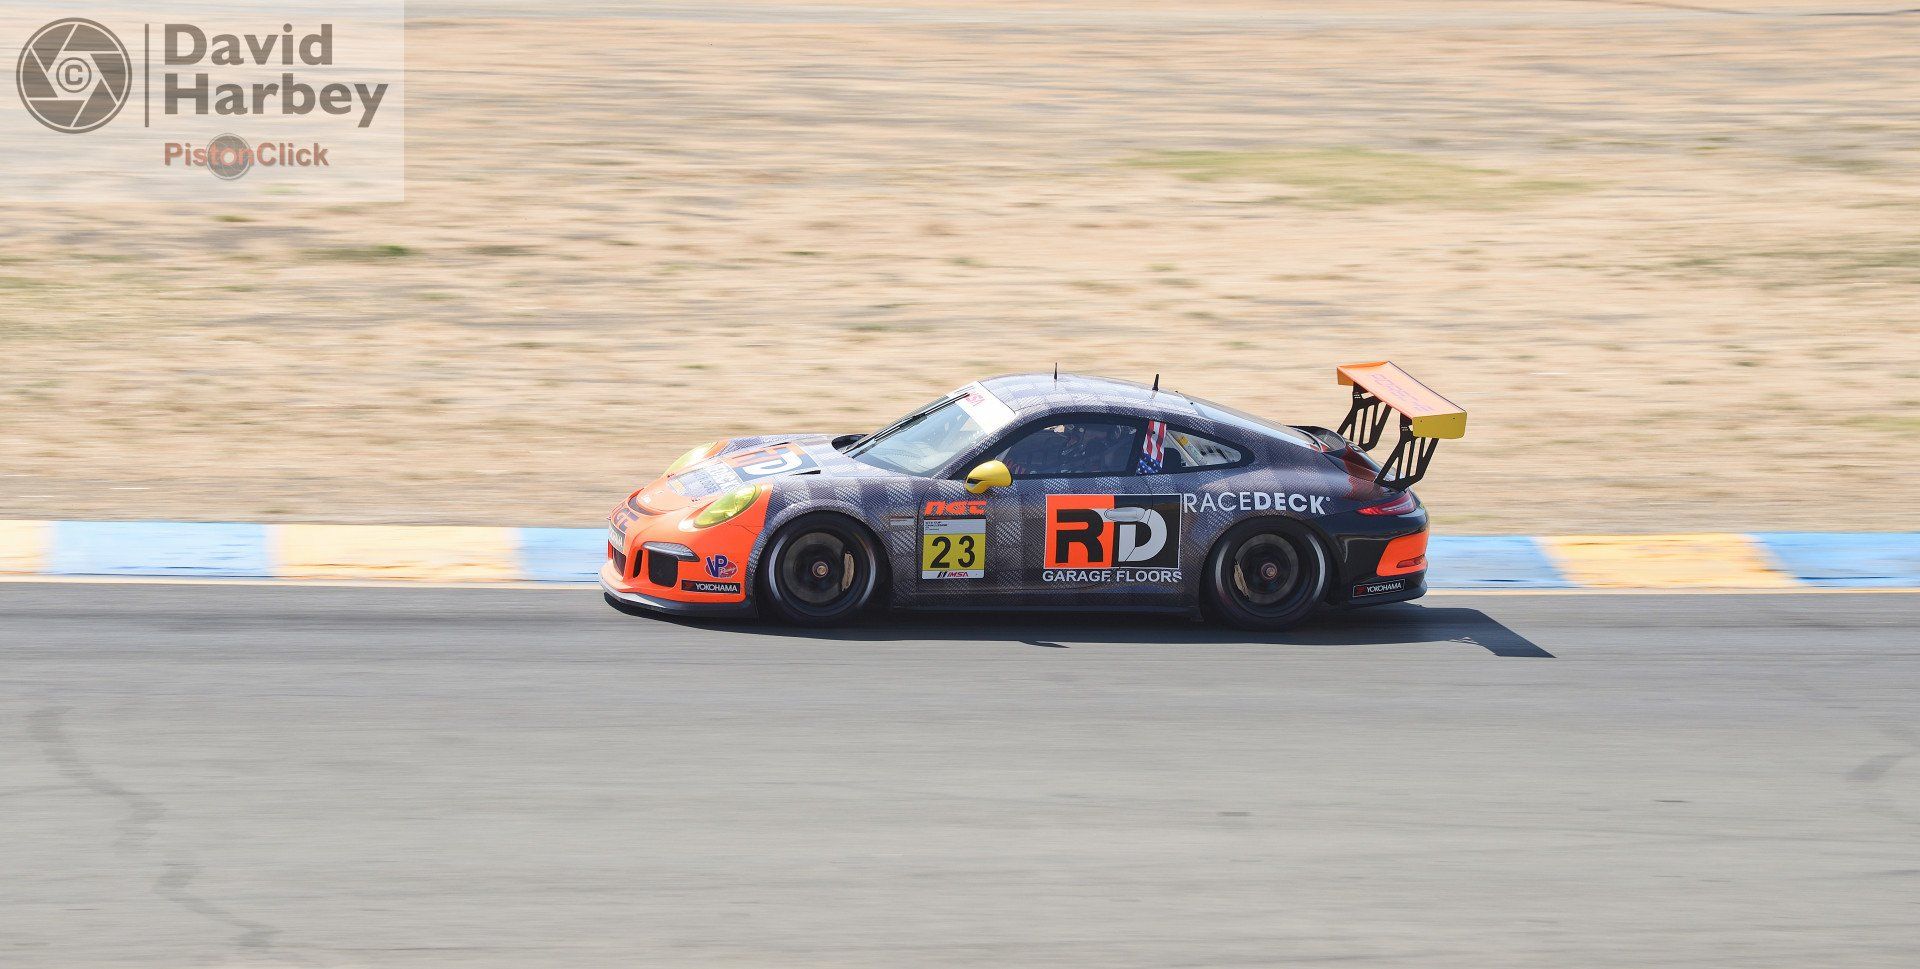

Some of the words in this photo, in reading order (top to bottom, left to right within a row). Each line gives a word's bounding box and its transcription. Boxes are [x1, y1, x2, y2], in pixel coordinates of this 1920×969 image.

[1055, 507, 1168, 563] RD
[930, 535, 976, 569] 23
[706, 555, 727, 578] VP
[1042, 570, 1111, 582] GARAGE
[1115, 569, 1183, 583] FLOORS
[695, 582, 738, 592] YOKOHAMA
[1366, 582, 1402, 593] YOKOHAMA
